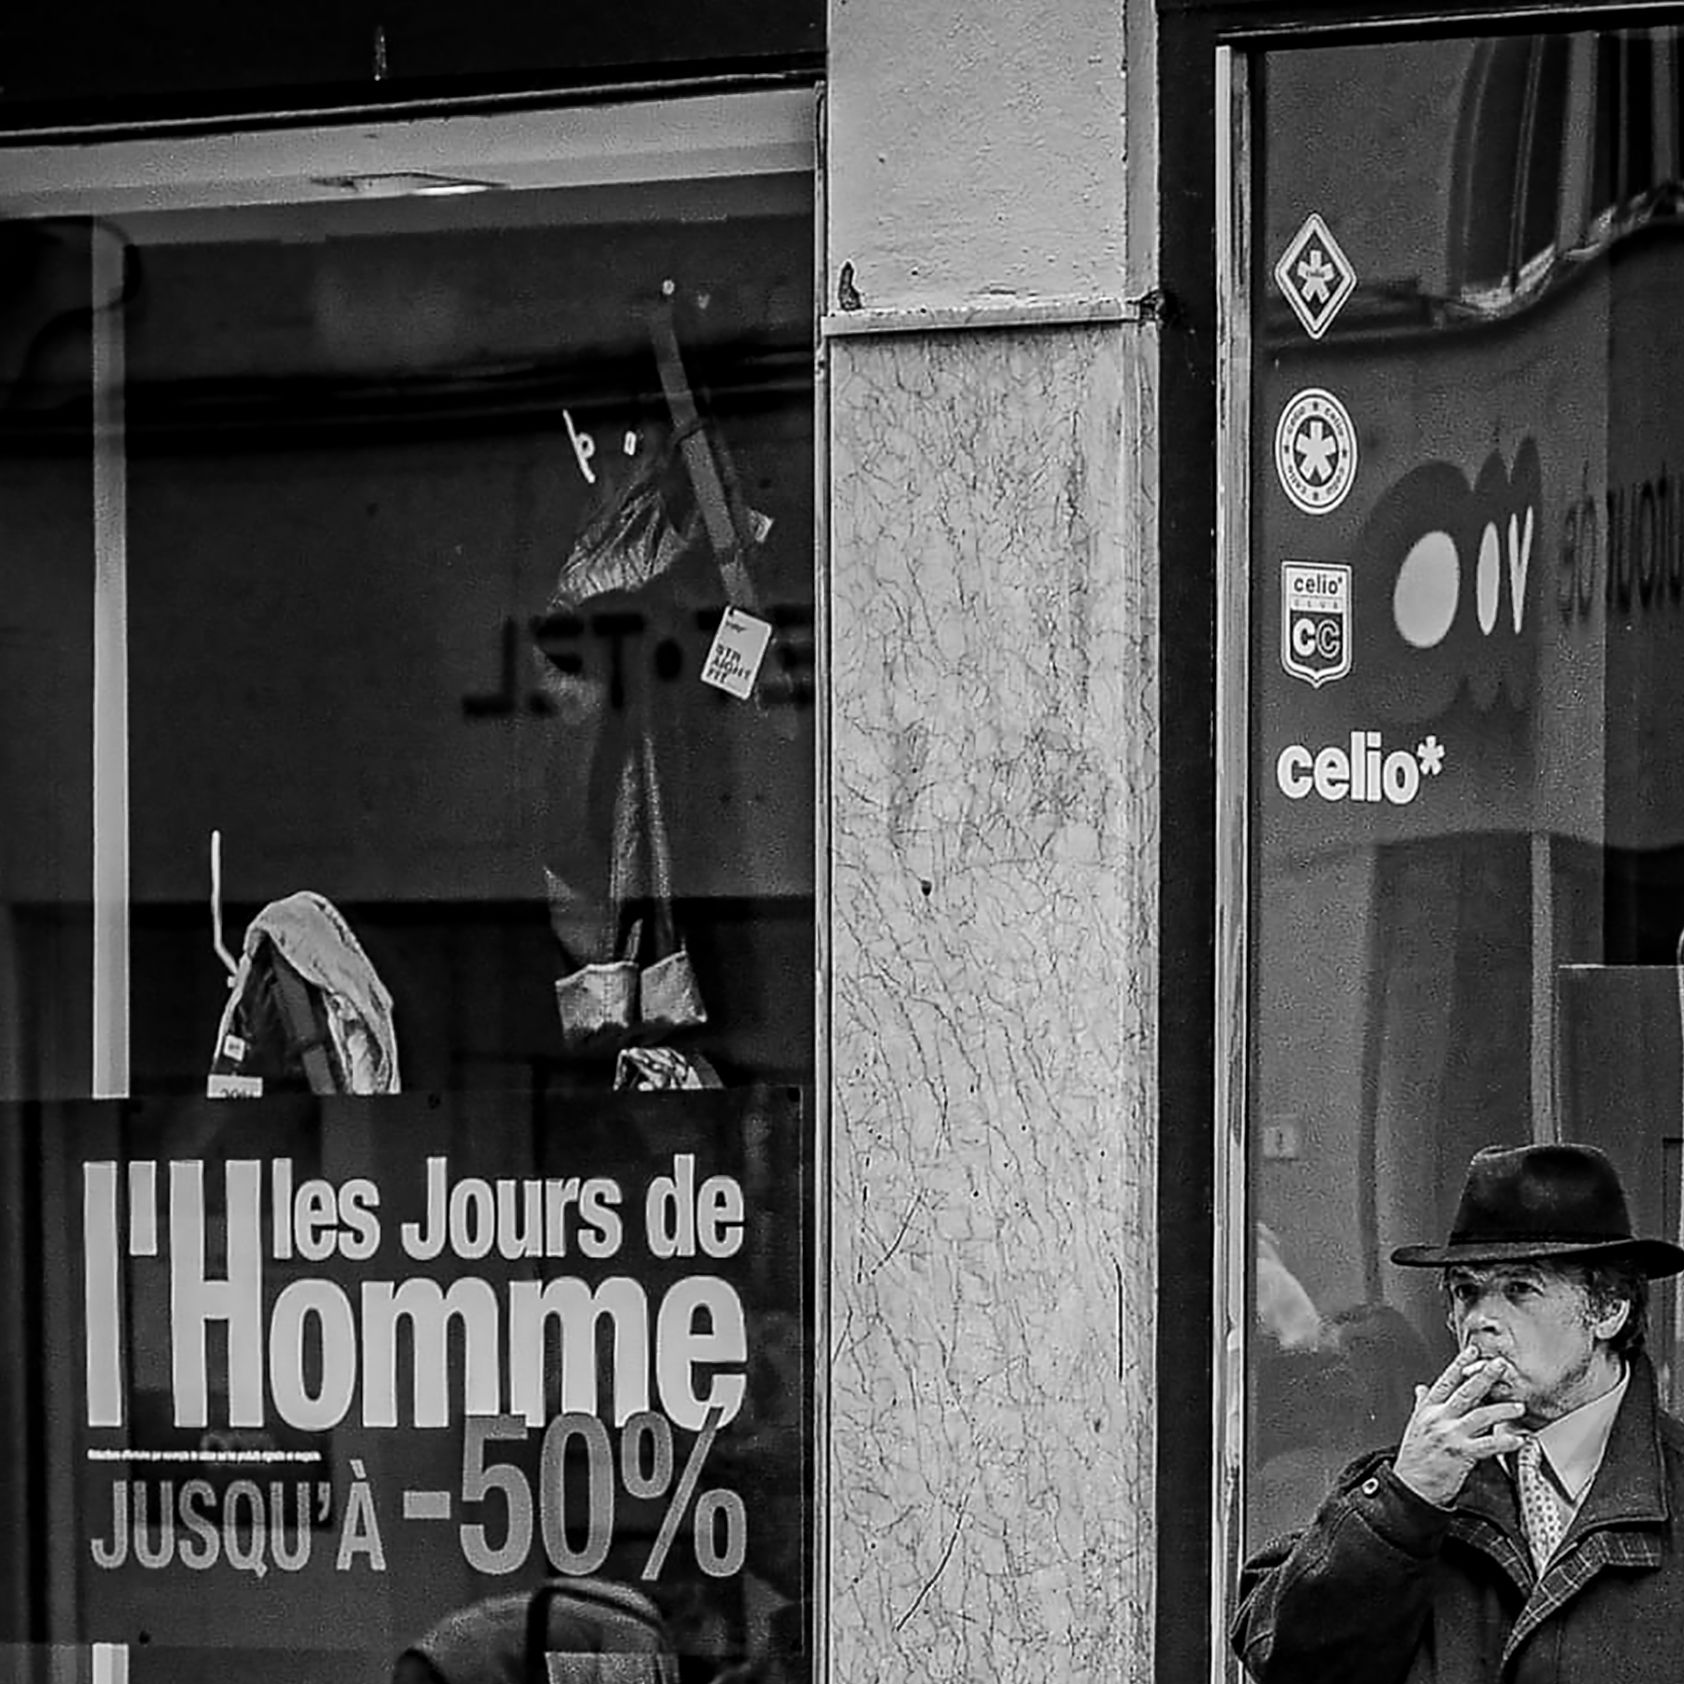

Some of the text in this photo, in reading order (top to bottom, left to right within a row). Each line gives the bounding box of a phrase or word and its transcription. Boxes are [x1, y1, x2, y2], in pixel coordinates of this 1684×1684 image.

[1293, 618, 1340, 658] CC
[273, 1153, 745, 1260] les Jours de
[84, 1158, 748, 1432] l'Homme
[403, 1406, 748, 1581] -50%
